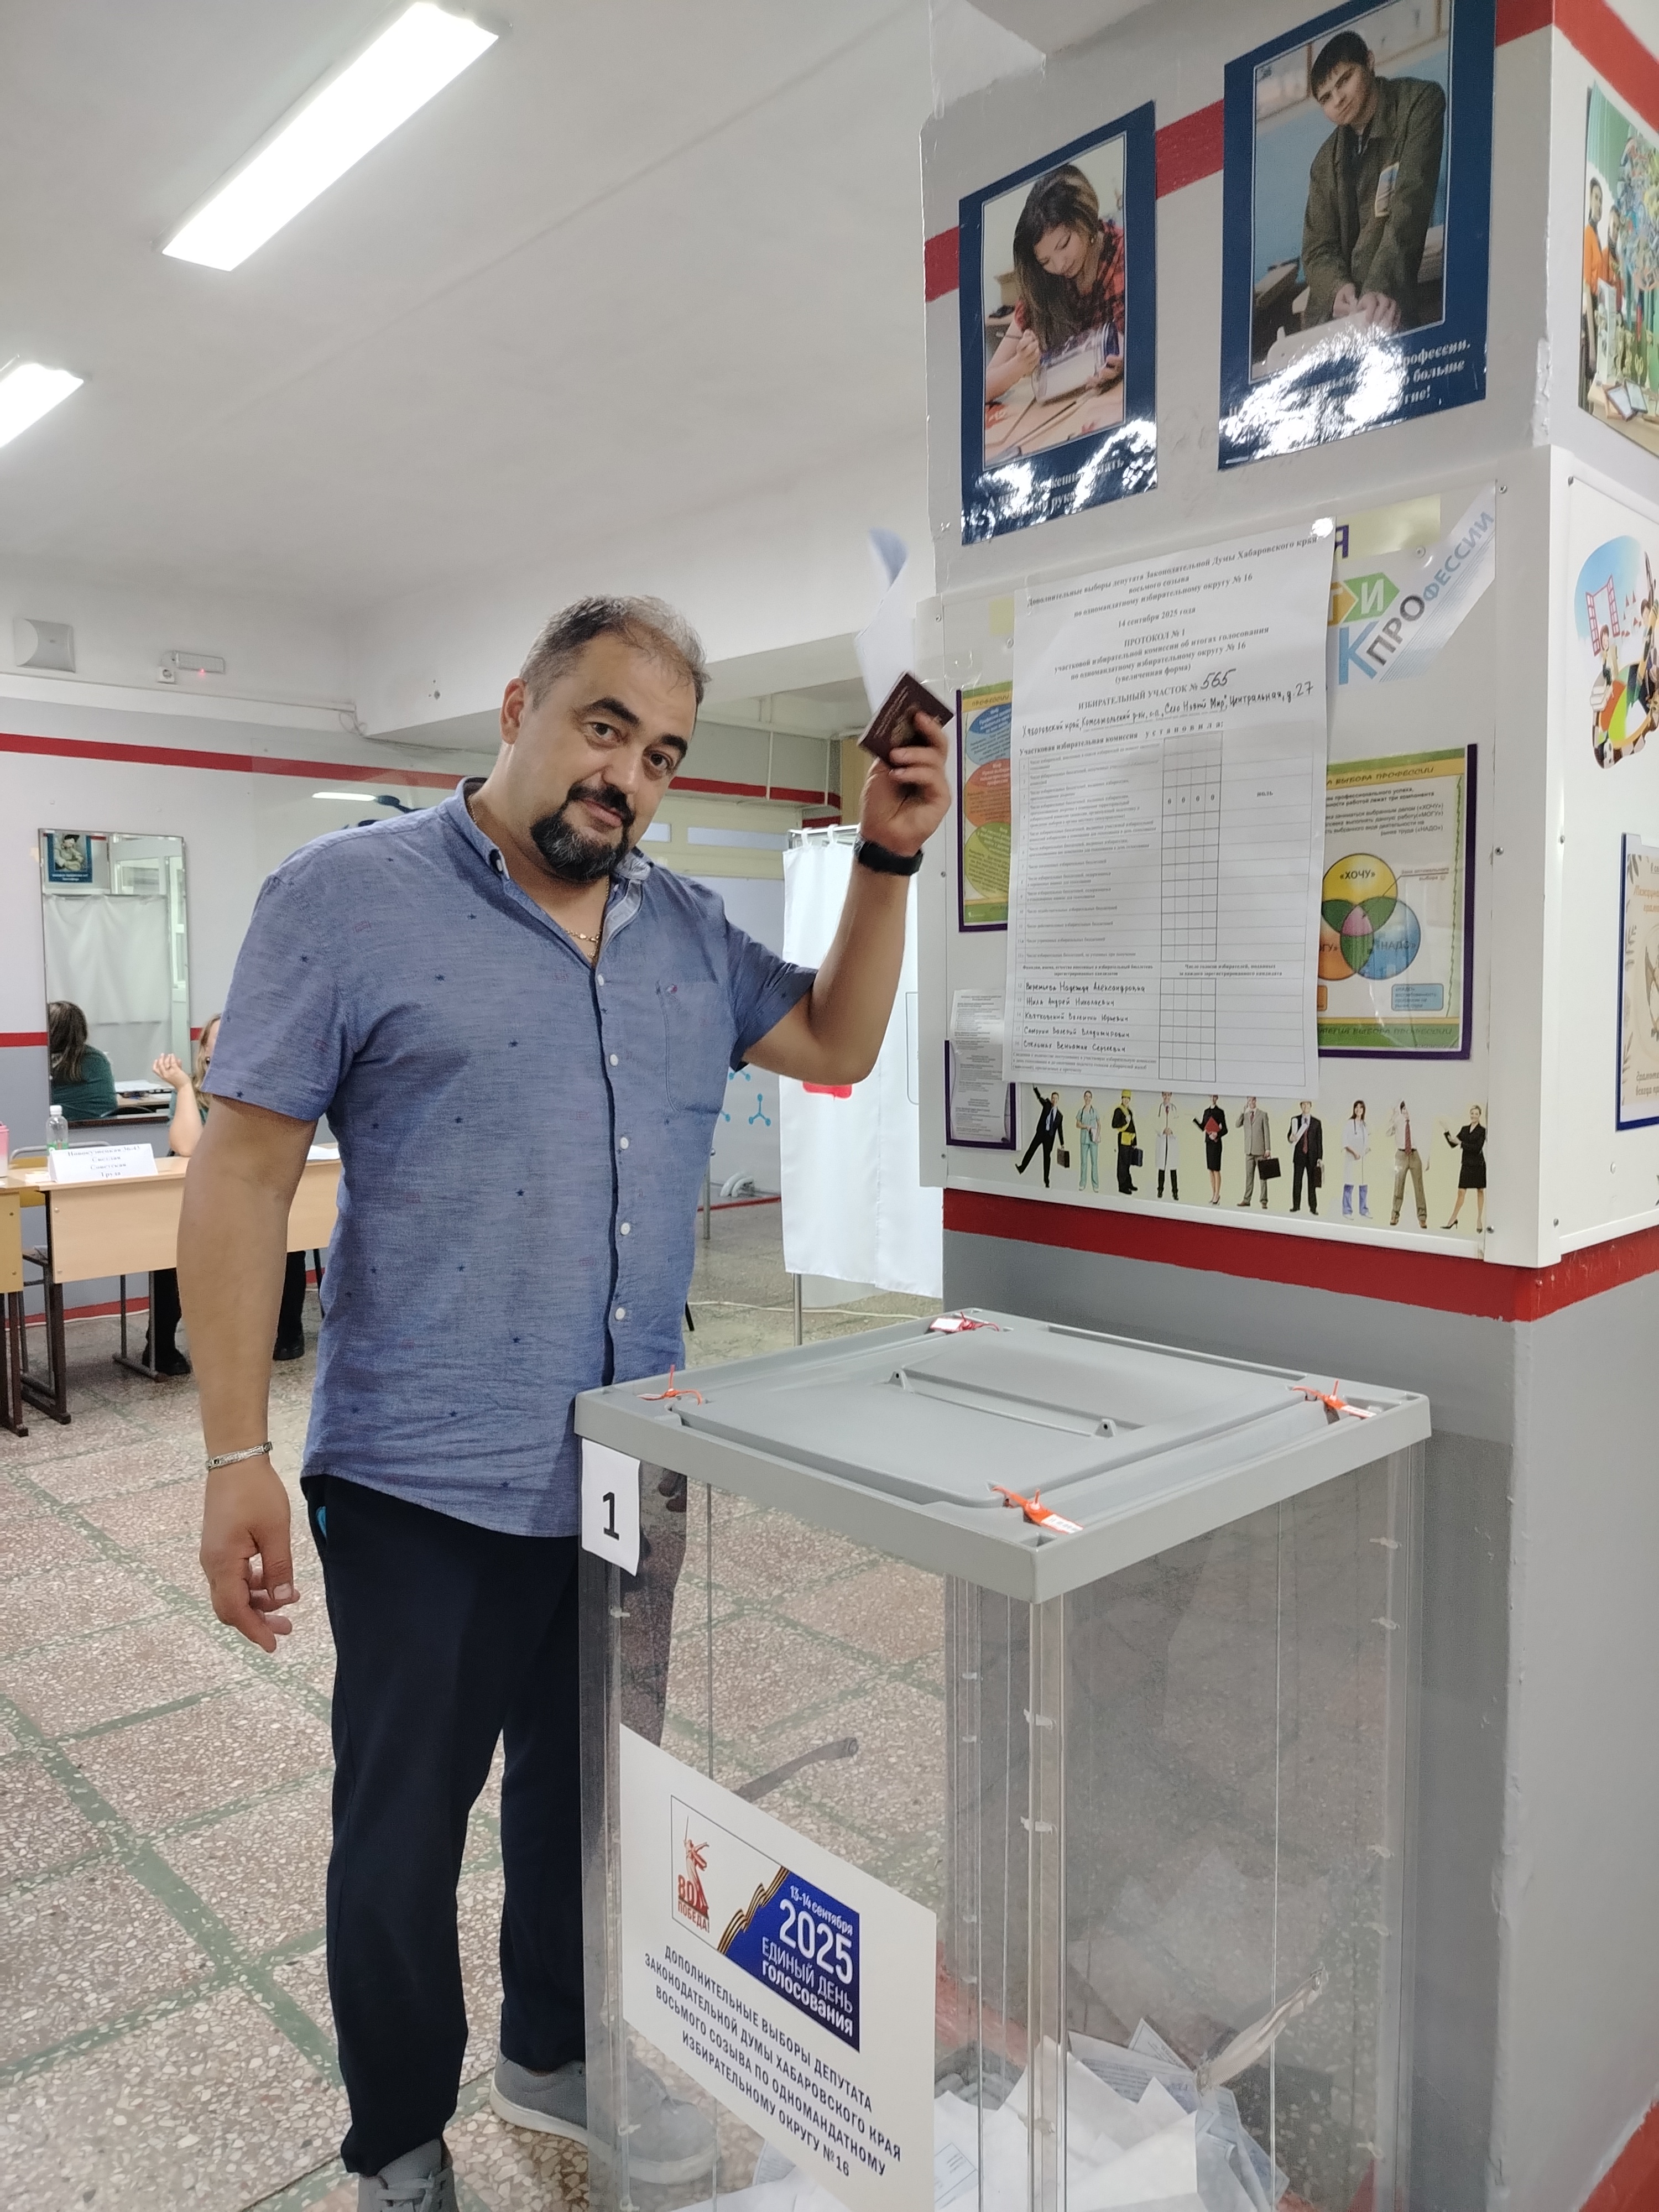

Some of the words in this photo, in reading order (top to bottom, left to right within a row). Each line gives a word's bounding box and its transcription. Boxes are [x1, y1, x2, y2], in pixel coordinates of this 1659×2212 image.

[1402, 340, 1470, 369] рофессии.
[1413, 360, 1465, 382] больше
[1027, 588, 1083, 607] Дополнительные
[1084, 582, 1111, 593] выборы
[1112, 575, 1144, 587] депутата
[1146, 559, 1211, 579] Законодательной
[1212, 554, 1235, 567] Думы
[1237, 542, 1295, 560] Хабаровского
[1083, 597, 1139, 615] одномандатному
[1141, 585, 1201, 603] избирательному
[1203, 578, 1230, 591] округу
[1243, 573, 1253, 582] 16
[1129, 583, 1161, 594] восьмого
[1162, 576, 1190, 587] созыва
[1366, 511, 1494, 667] ПРОФЕССИИ
[1118, 619, 1126, 628] 14
[1127, 614, 1160, 627] сентября
[1161, 608, 1178, 619] 2025
[1179, 606, 1196, 616] года
[1054, 661, 1091, 675] участковой
[1092, 650, 1142, 665] избирательной
[1144, 644, 1179, 655] комиссии
[1181, 639, 1190, 648] об
[1191, 637, 1217, 646] итогах
[1218, 627, 1270, 641] голосования
[1080, 662, 1135, 678] одномандатному
[1136, 650, 1196, 668] избирательному
[1197, 646, 1224, 658] округу
[1237, 641, 1246, 651] 16
[1124, 634, 1170, 648] ПРОТОКОЛ
[1338, 620, 1379, 685] К
[1078, 690, 1146, 711] ИЗБИРАТЕЛЬНЫЙ
[1147, 684, 1188, 699] УЧАСТОК
[1200, 668, 1237, 690] 565
[1115, 669, 1162, 685] (увеличенная
[1164, 664, 1191, 675] форма)
[1295, 681, 1314, 697] 27
[1019, 744, 1055, 757] Участковая
[1056, 737, 1104, 752] избирательная
[1105, 732, 1138, 743] комиссия
[1339, 869, 1376, 880] «ХОЧУ»
[1048, 996, 1071, 1008] Андрей
[1074, 996, 1115, 1007] Николаевич
[1060, 980, 1089, 993] Надежда
[1093, 981, 1146, 993] Александровна
[1081, 1027, 1130, 1039] Владимирович
[603, 1491, 620, 1541] 1
[678, 1900, 709, 1934] ПОБЕДА!
[790, 1885, 811, 1909] 13-14
[812, 1901, 853, 1936] сентября
[779, 1898, 853, 1984] 2025
[762, 1936, 815, 1988] ЕДИНЫЙ
[818, 1975, 853, 2013] ДЕНЬ
[665, 1945, 759, 2027] ДОПОЛНИТЕЛЬНЫЕ
[761, 2018, 811, 2067] ВЫБОРЫ
[814, 2058, 872, 2113] ДЕПУТАТА
[645, 1953, 737, 2036] ЗАКОНОДАТЕЛЬНОЙ
[741, 2028, 773, 2064] ДУМЫ
[776, 2054, 865, 2134] ХАБАРОВСКОГО
[869, 2125, 901, 2162] КРАЯ
[656, 1985, 706, 2036] ВОСЬМОГО
[709, 2028, 752, 2073] СОЗЫВА
[755, 2063, 769, 2085] ПО
[772, 2078, 885, 2176] ОДНОМАНДАТНОМУ
[682, 2030, 776, 2116] ИЗБИРАТЕЛЬНОМУ
[779, 2110, 820, 2151] ОКРУГУ
